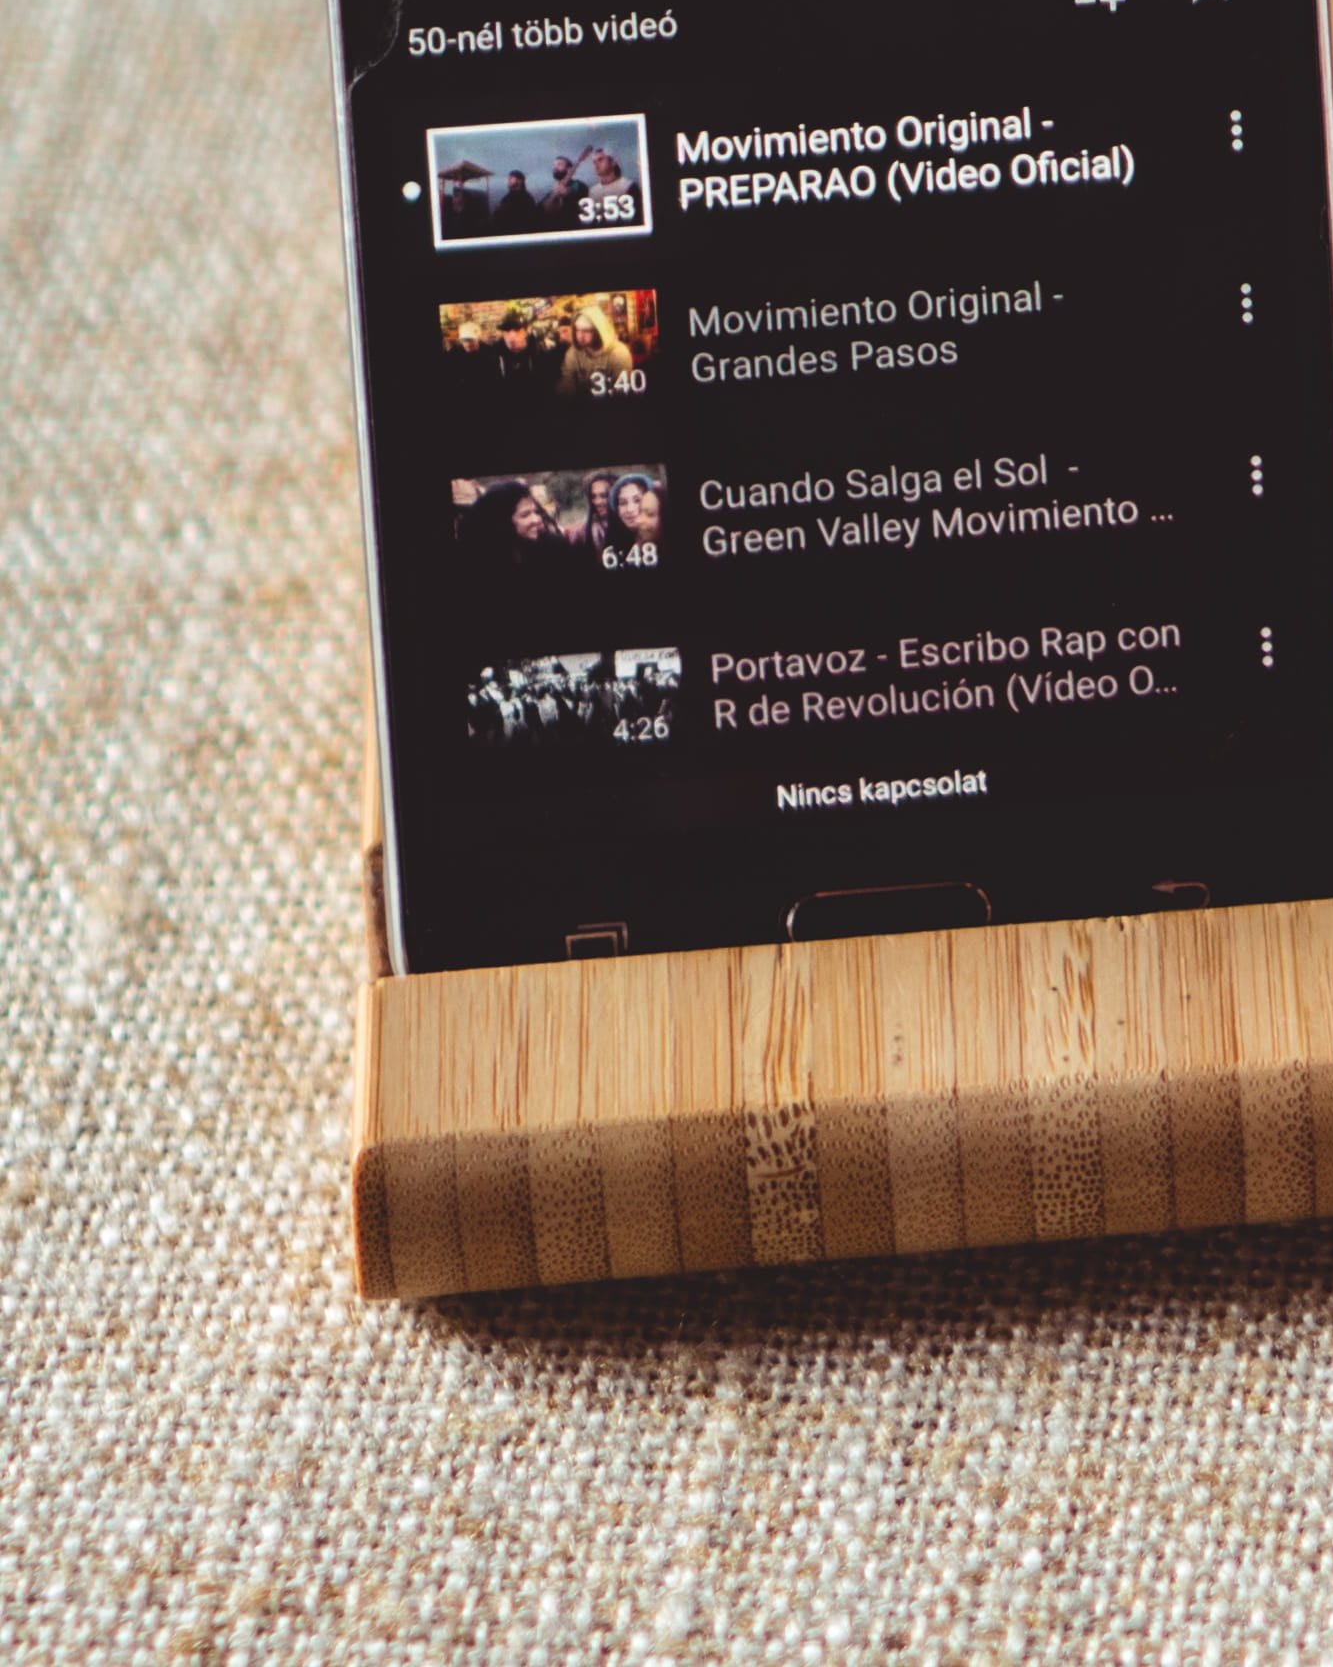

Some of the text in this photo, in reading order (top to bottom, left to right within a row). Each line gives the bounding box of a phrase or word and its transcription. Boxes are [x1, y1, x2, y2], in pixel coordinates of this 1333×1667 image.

[408, 8, 678, 56] 50-nél több videó
[676, 121, 887, 165] Movimiento
[896, 106, 1032, 153] Original
[678, 143, 1135, 211] PREPARAO (Video Oficial)
[577, 191, 637, 223] 3:53
[688, 296, 897, 337] Movimiento
[908, 280, 1042, 324] Original
[589, 368, 648, 396] 3:40
[691, 340, 958, 383] Grandes Pasos
[699, 471, 835, 511] Cuando
[846, 465, 943, 503] Salga
[953, 458, 982, 491] el
[994, 453, 1047, 488] Sol
[702, 525, 806, 557] Green
[816, 512, 920, 549] Valley
[932, 497, 1139, 539] Movimiento
[601, 543, 660, 570] 6:48
[711, 649, 866, 684] Portavoz
[899, 630, 1030, 669] Escribo
[1040, 627, 1107, 661] Rap
[1117, 624, 1181, 651] con
[714, 698, 737, 729] R
[748, 694, 791, 726] de
[802, 678, 995, 722] Revolución
[1006, 669, 1119, 713] (Vídeo
[612, 715, 671, 743] 4:26
[776, 769, 988, 809] Nincs kapcsolat
